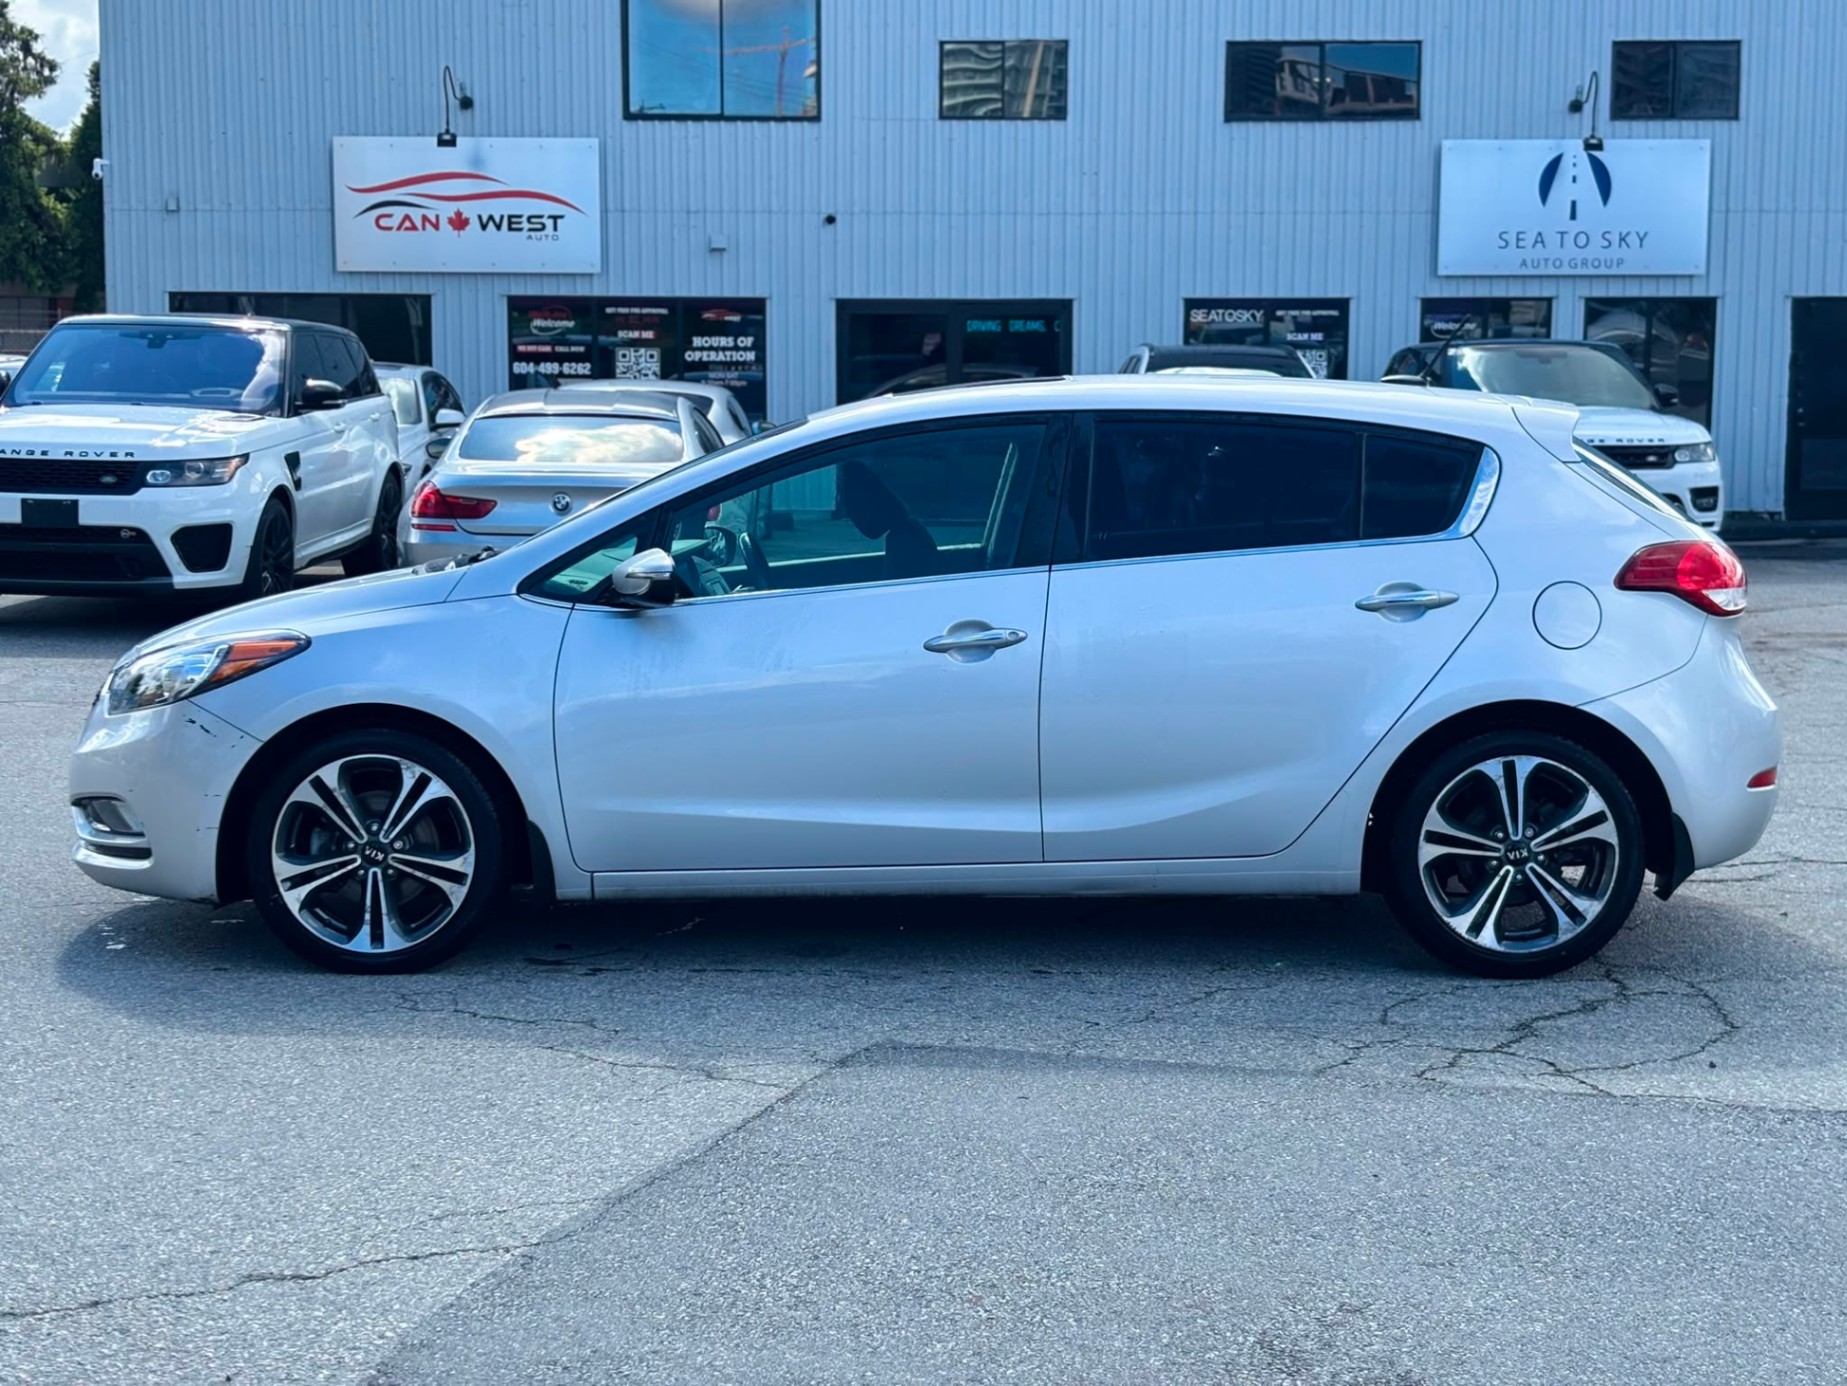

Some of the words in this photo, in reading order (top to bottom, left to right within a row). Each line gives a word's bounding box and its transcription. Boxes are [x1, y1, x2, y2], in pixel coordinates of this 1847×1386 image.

[374, 213, 440, 231] CAN
[477, 214, 565, 232] WEST
[1497, 231, 1546, 249] SEA
[1556, 231, 1590, 249] TO
[1601, 231, 1649, 249] SKY
[1519, 258, 1563, 269] AUTO
[1568, 258, 1625, 269] GROUP
[966, 319, 1002, 332] DRIVING
[617, 330, 640, 339] SCAN
[641, 330, 655, 339] ME
[1286, 332, 1309, 341] SCAN
[692, 335, 735, 348] HOURS
[736, 336, 755, 348] OF
[684, 349, 756, 362] OPERATION
[512, 361, 592, 375] 604-499-6262
[0, 448, 49, 457] ANGE
[64, 450, 135, 458] ROVER
[364, 845, 385, 862] KIA
[1506, 847, 1529, 861] KIA
